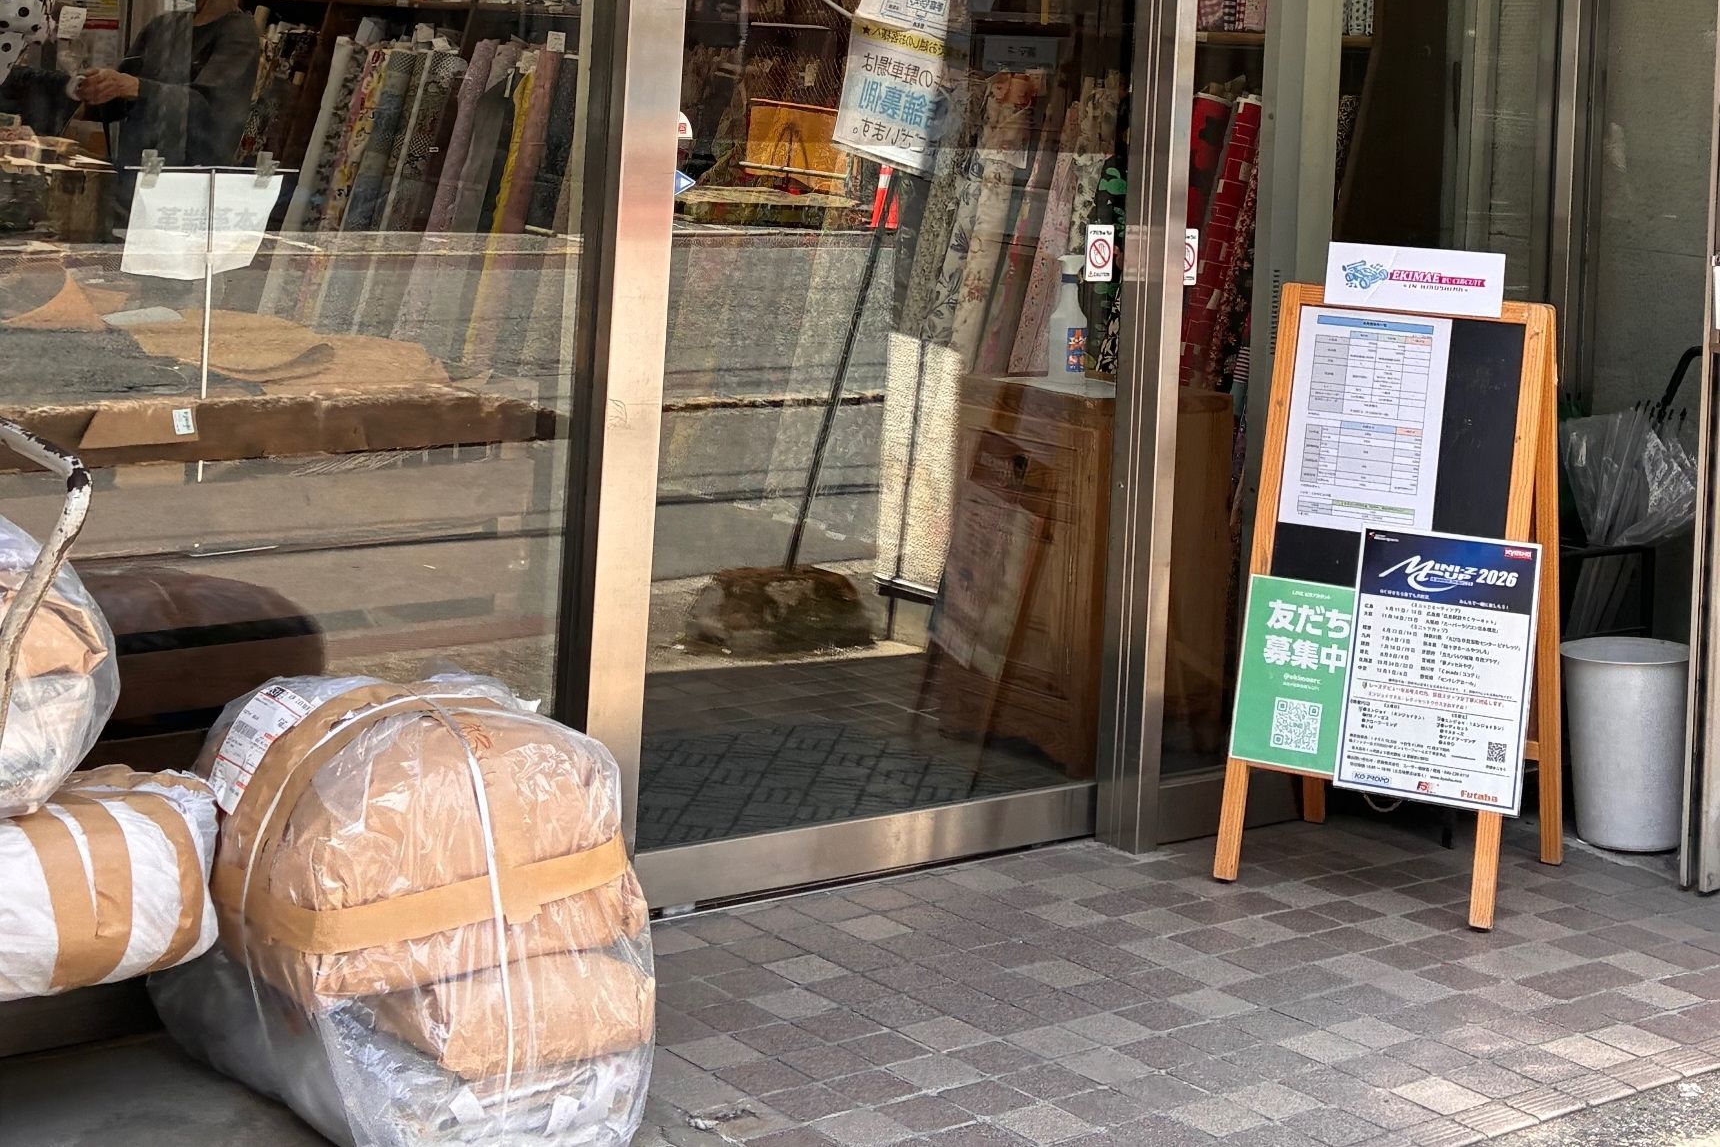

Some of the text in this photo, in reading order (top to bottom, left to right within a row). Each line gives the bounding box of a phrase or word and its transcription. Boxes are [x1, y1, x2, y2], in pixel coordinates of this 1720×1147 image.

[1391, 269, 1441, 284] EKIMAE
[1478, 568, 1519, 588] 2026
[1267, 599, 1352, 640] 友だち
[1262, 634, 1348, 674] 募集中
